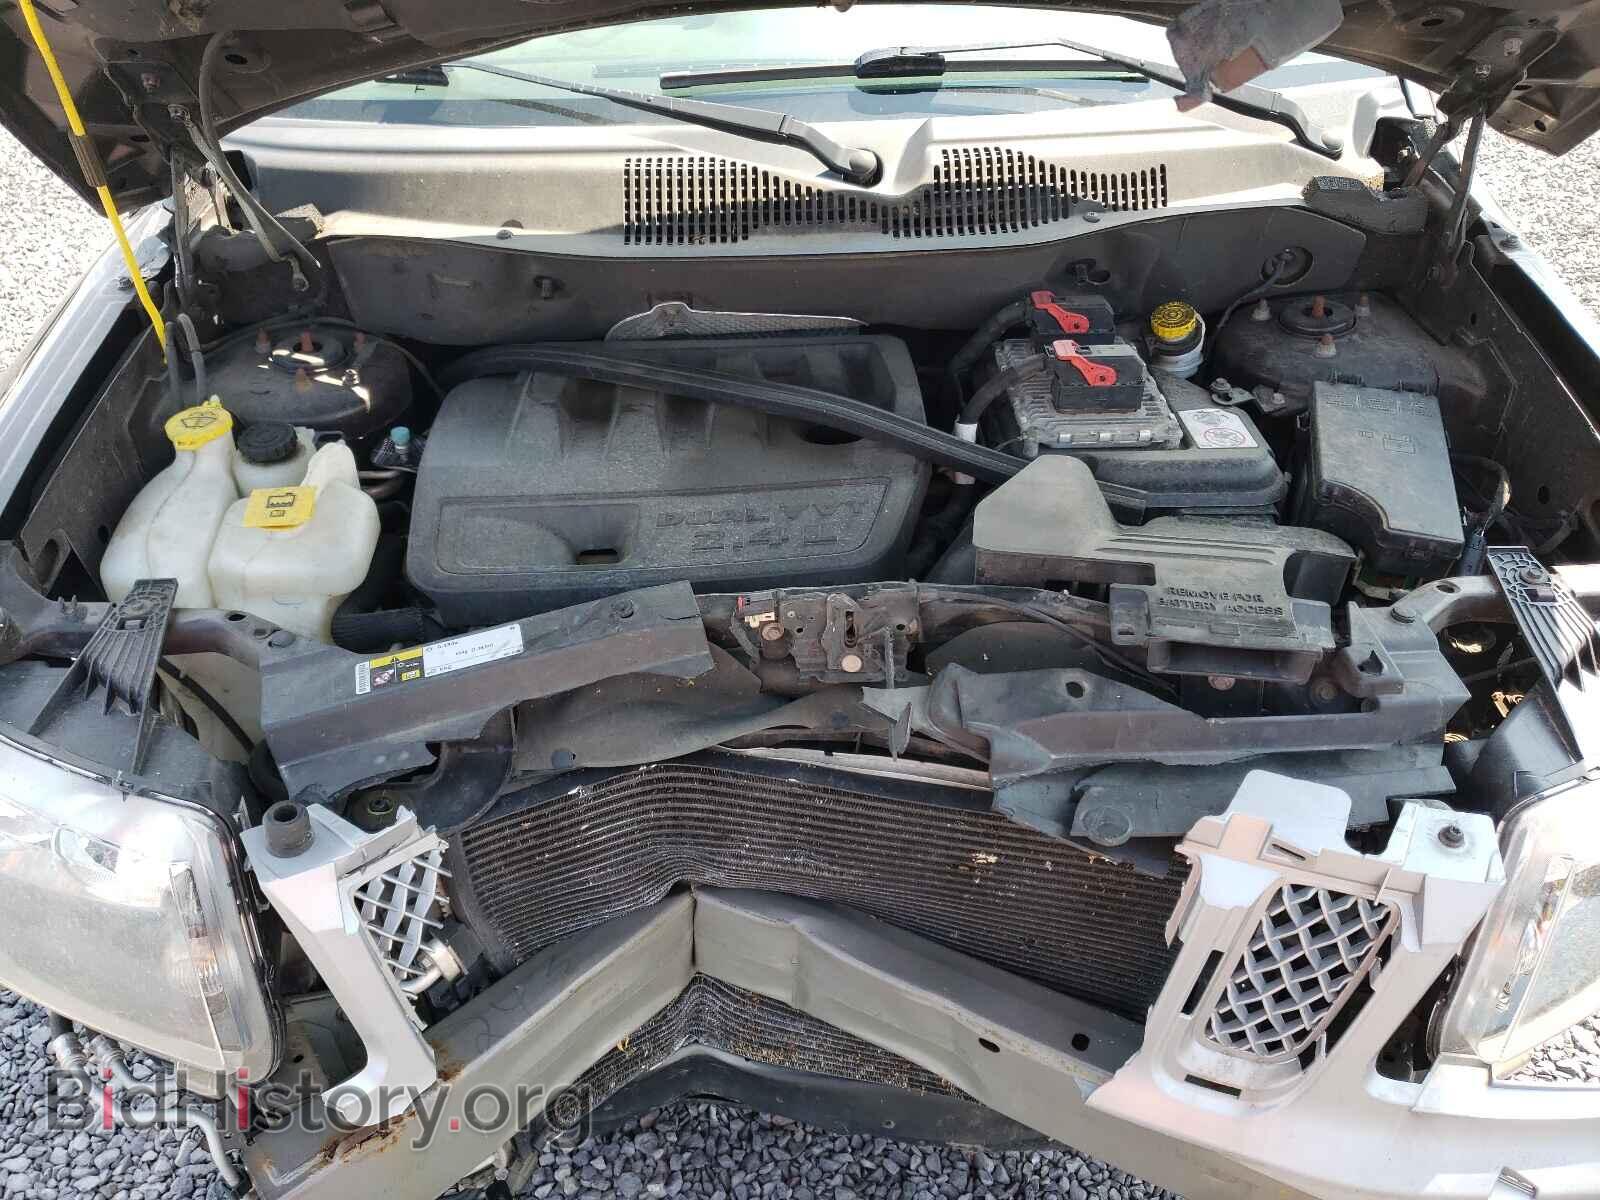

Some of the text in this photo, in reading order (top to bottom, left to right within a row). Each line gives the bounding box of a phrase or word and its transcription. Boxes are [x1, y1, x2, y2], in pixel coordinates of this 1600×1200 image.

[1166, 585, 1264, 603] REMOVE FOR
[1158, 597, 1284, 617] BATTERY ACCESS
